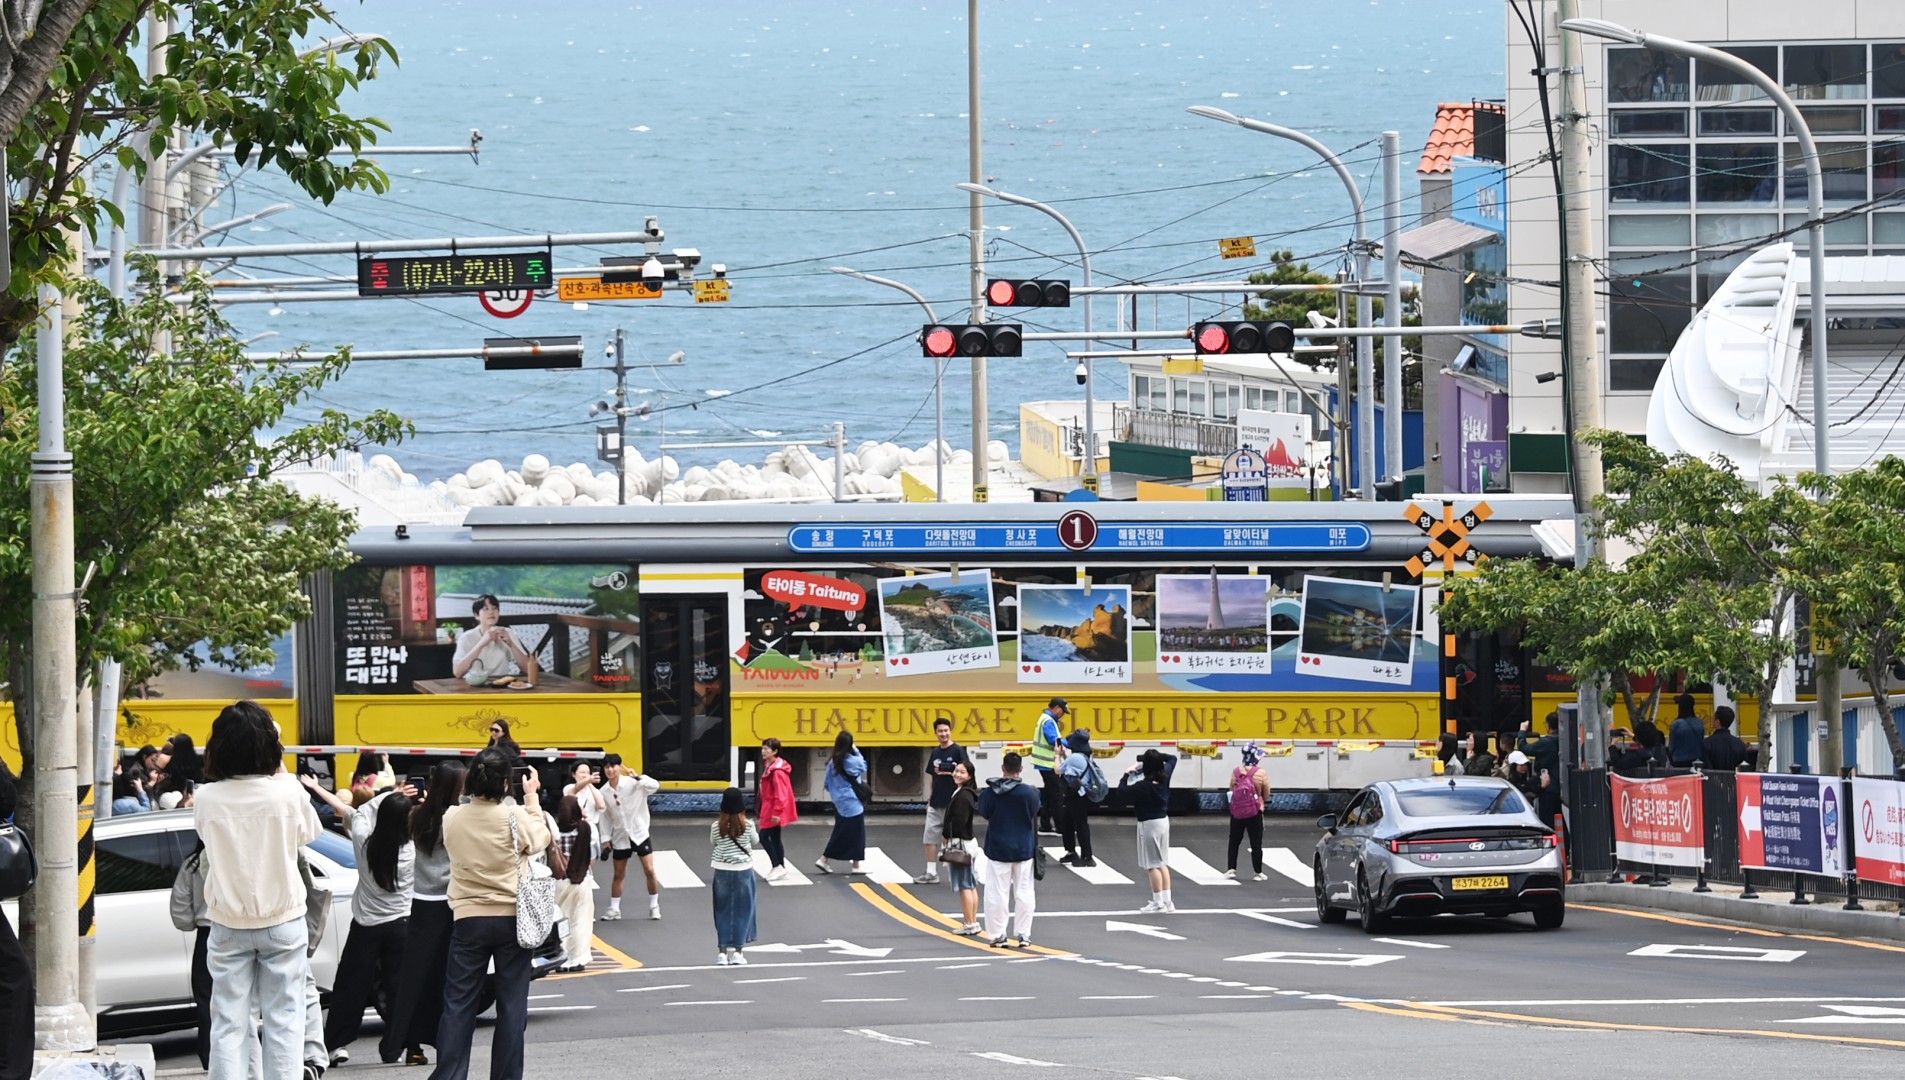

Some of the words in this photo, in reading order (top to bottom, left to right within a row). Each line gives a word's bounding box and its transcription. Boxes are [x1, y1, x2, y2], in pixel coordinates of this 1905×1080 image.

[526, 259, 546, 283] 주
[705, 282, 716, 290] kt
[1420, 516, 1431, 528] 멈
[1465, 515, 1475, 527] 멈
[1070, 517, 1083, 543] 1
[1329, 528, 1347, 540] 미포
[767, 577, 806, 596] 타이동
[808, 583, 860, 605] Taitung
[346, 646, 367, 666] 또
[370, 645, 408, 664] 만나
[345, 665, 398, 684] 대만!
[740, 668, 819, 681] TAIWAN
[1266, 707, 1380, 736] PARK
[1481, 877, 1505, 888] 2264
